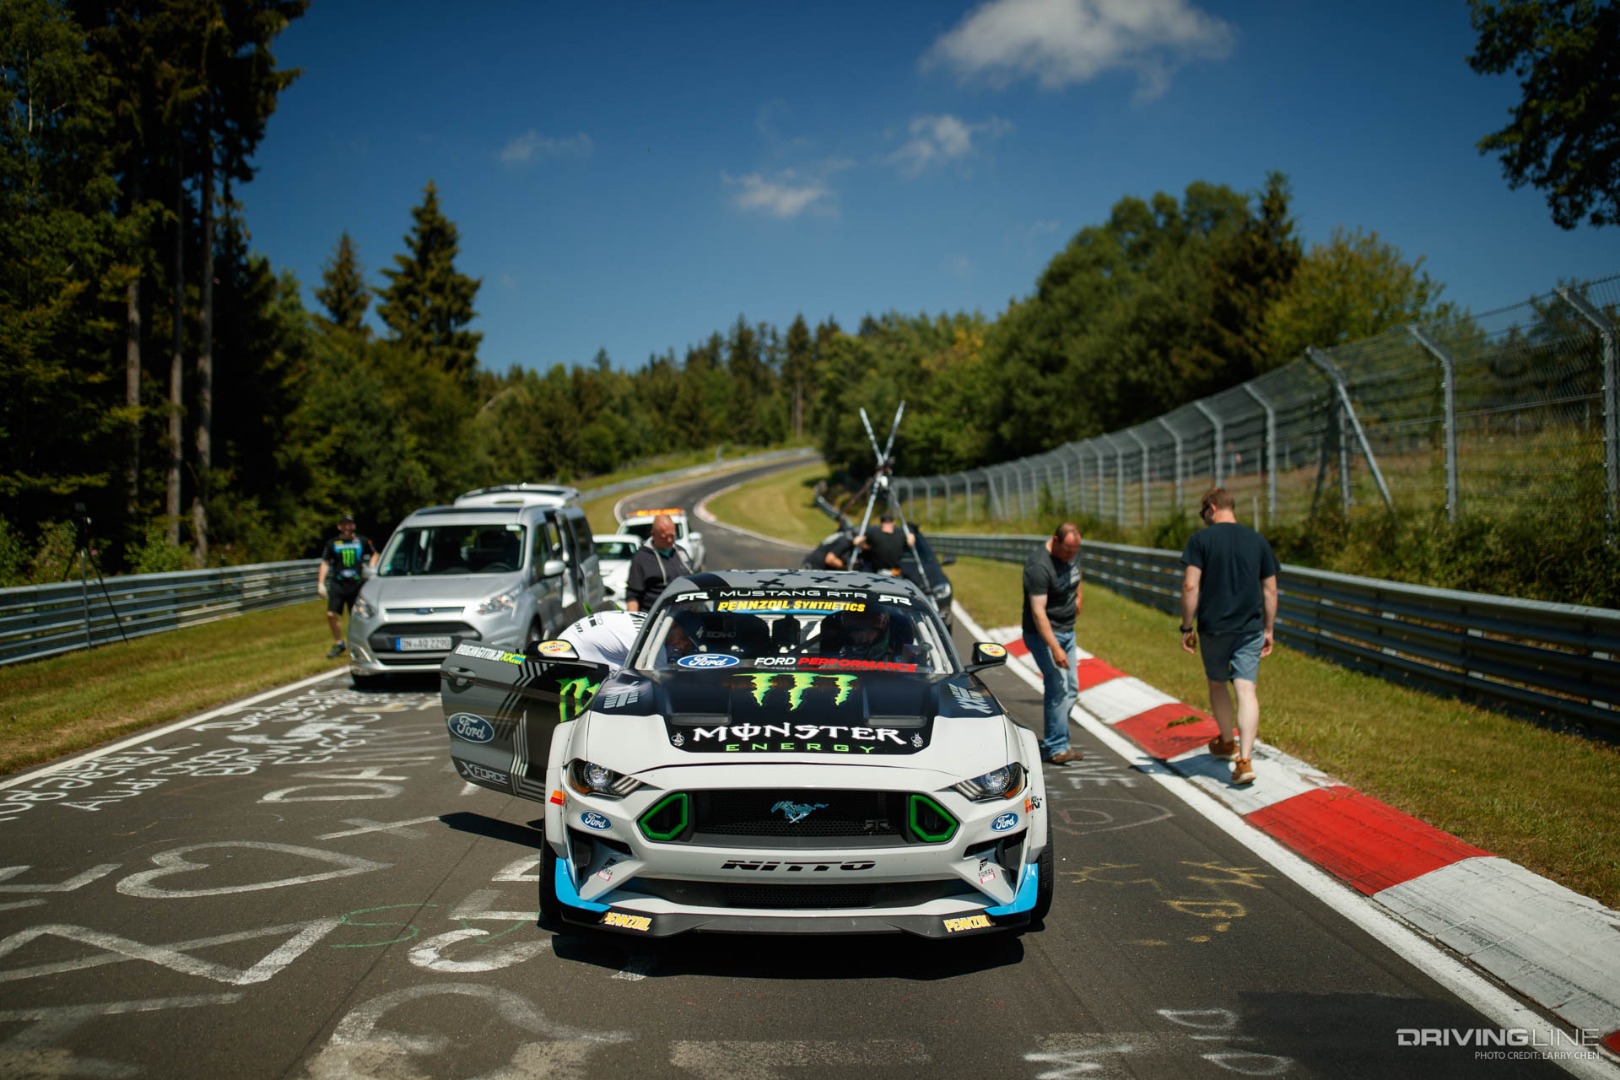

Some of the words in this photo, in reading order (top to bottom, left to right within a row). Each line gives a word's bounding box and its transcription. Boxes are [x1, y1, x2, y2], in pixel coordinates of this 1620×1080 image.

[720, 590, 820, 598] MUSTANG
[826, 591, 867, 599] RTR
[717, 599, 790, 612] PENNZOIL
[793, 600, 867, 612] SYNTHETICS
[687, 654, 728, 667] Ford
[754, 657, 796, 666] FORD
[797, 657, 918, 673] PERFORMANCE
[457, 714, 487, 740] Ford
[693, 722, 907, 745] MONSTER
[725, 742, 875, 754] ENERGY
[584, 812, 607, 829] Ford
[995, 814, 1016, 829] Ford
[720, 860, 877, 872] NITTO
